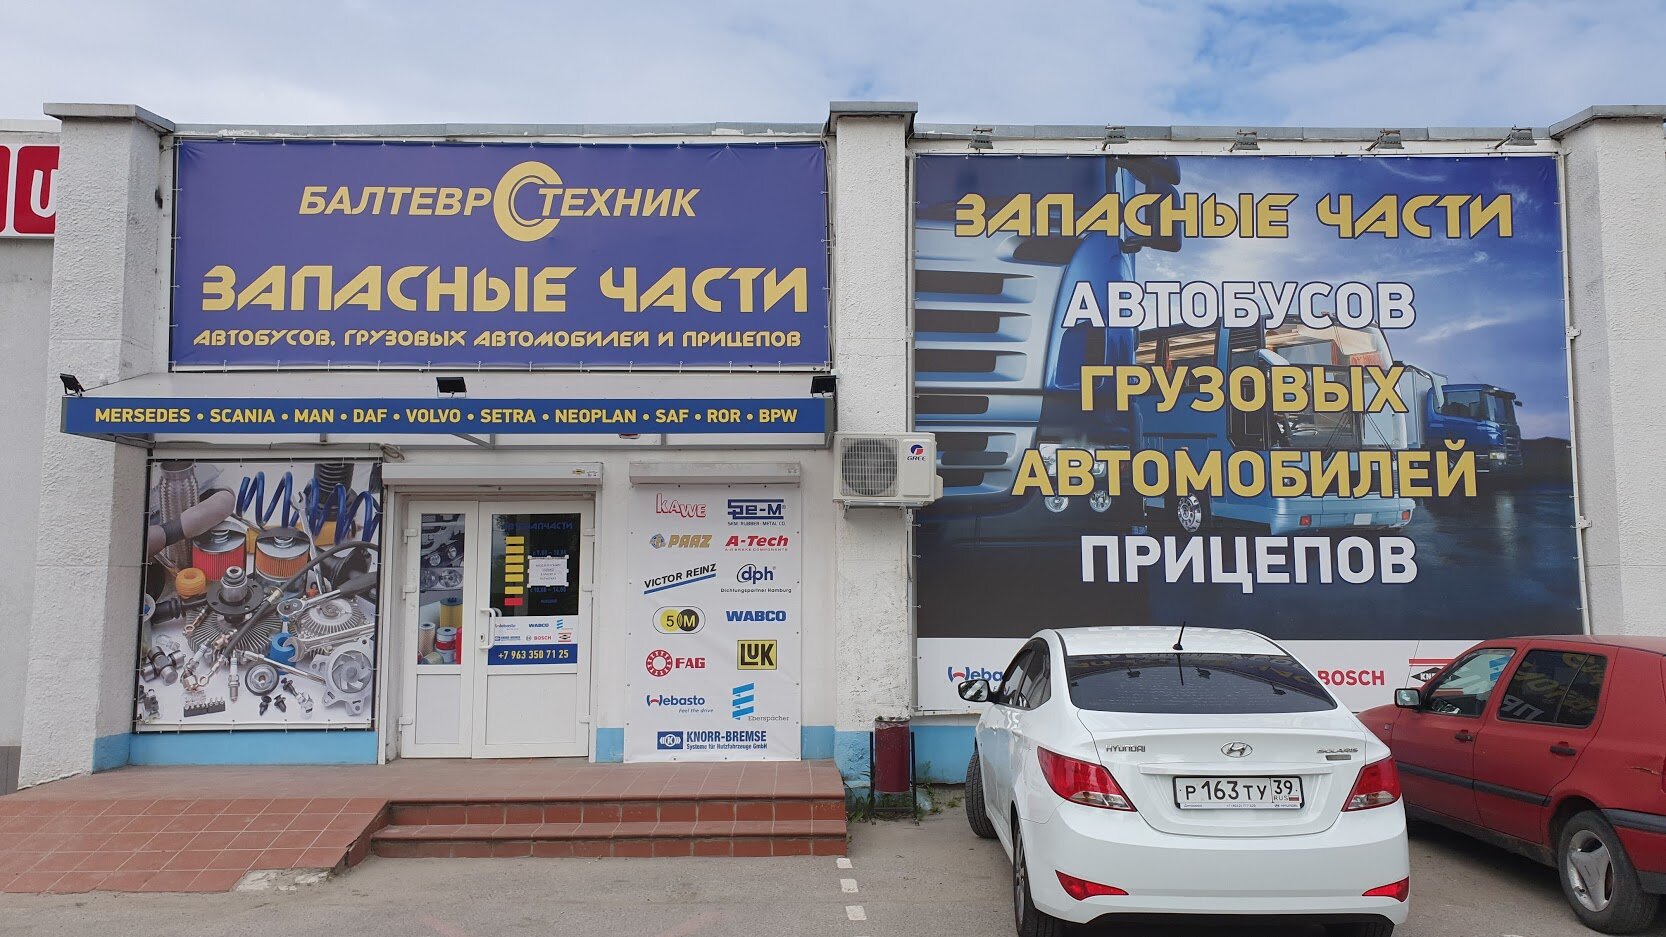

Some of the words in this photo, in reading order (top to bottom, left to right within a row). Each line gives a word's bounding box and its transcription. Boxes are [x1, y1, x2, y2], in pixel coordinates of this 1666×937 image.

[954, 192, 1299, 238] ЗАПАСНЫЕ
[1316, 193, 1513, 239] ЧАСТИ
[202, 265, 577, 312] ЗАПАСНЫЕ
[599, 266, 808, 313] ЧАСТИ
[1061, 280, 1417, 330] АВТОБУСОВ
[193, 329, 336, 347] АВТОБУСОВ,
[344, 330, 467, 347] ГРУЗОВЫХ
[473, 330, 650, 347] АВТОМОБИЛЕЙ
[658, 331, 674, 347] И
[682, 331, 801, 347] ПРИЦЕПОВ
[1079, 365, 1409, 413] ГРУЗОВЫХ
[95, 408, 191, 424] MERSEDES
[209, 408, 276, 424] SCANIA
[294, 408, 334, 424] MAN
[352, 408, 388, 424] DAF
[406, 408, 461, 424] VOLVO
[480, 408, 536, 424] SETRA
[555, 408, 637, 424] NEOPLAN
[655, 408, 689, 424] SAF
[707, 408, 741, 424] ROR
[758, 408, 798, 424] BPW
[1010, 439, 1478, 499] АВТОМОБИЛЕЙ
[668, 534, 713, 549] PAAZ
[725, 535, 789, 547] A-Tech
[1080, 535, 1418, 594] ПРИЦЕПОВ
[644, 572, 683, 589] VICTOR
[686, 563, 717, 579] REINZ
[741, 566, 774, 584] dph
[726, 610, 787, 622] WABCO
[498, 651, 509, 660] +7
[511, 650, 526, 659] 963
[546, 650, 556, 659] 71
[559, 649, 569, 658] 25
[675, 658, 706, 669] FAG
[1317, 670, 1385, 686] BOSCH
[647, 694, 706, 707] Webasto
[686, 730, 767, 742] KNORR-BREMSE
[1105, 745, 1146, 753] HYUNDAI
[1273, 779, 1293, 795] 39
